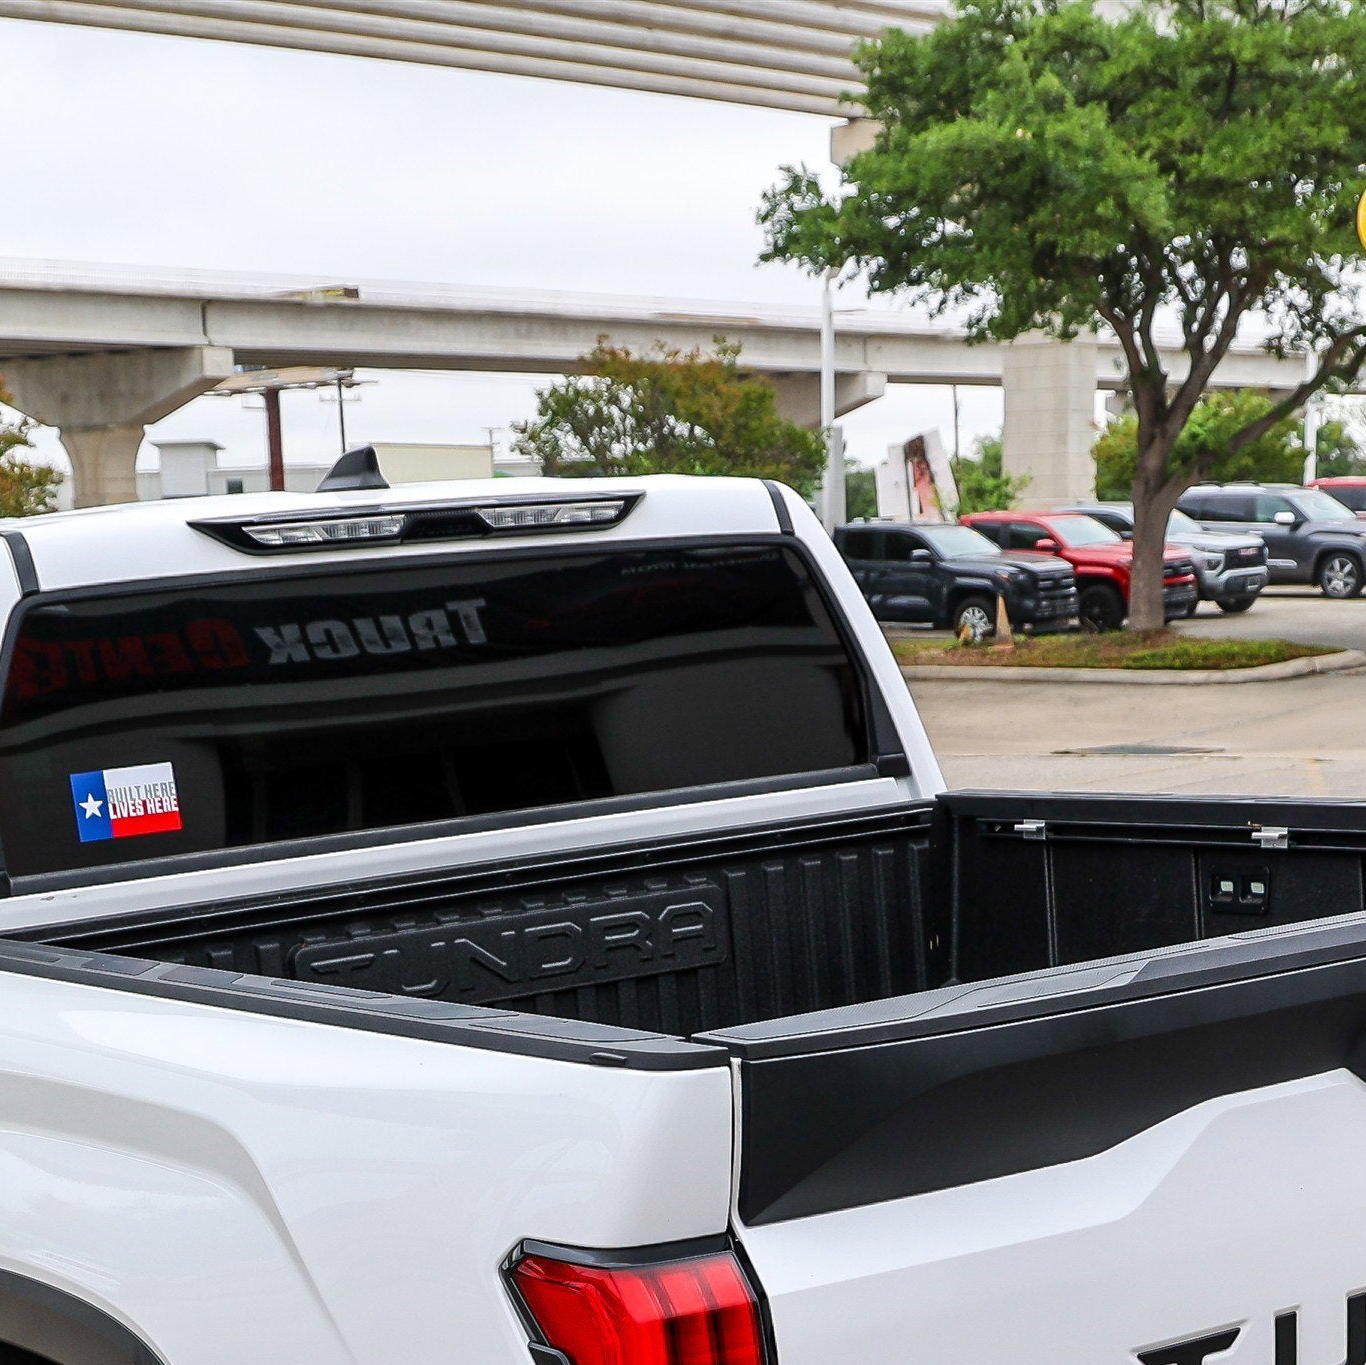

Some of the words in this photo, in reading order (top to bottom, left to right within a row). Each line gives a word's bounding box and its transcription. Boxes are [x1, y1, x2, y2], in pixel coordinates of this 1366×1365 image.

[107, 785, 143, 803] BUILT
[143, 781, 176, 801] HERE
[109, 799, 145, 820] LIVES
[145, 796, 179, 815] HERE
